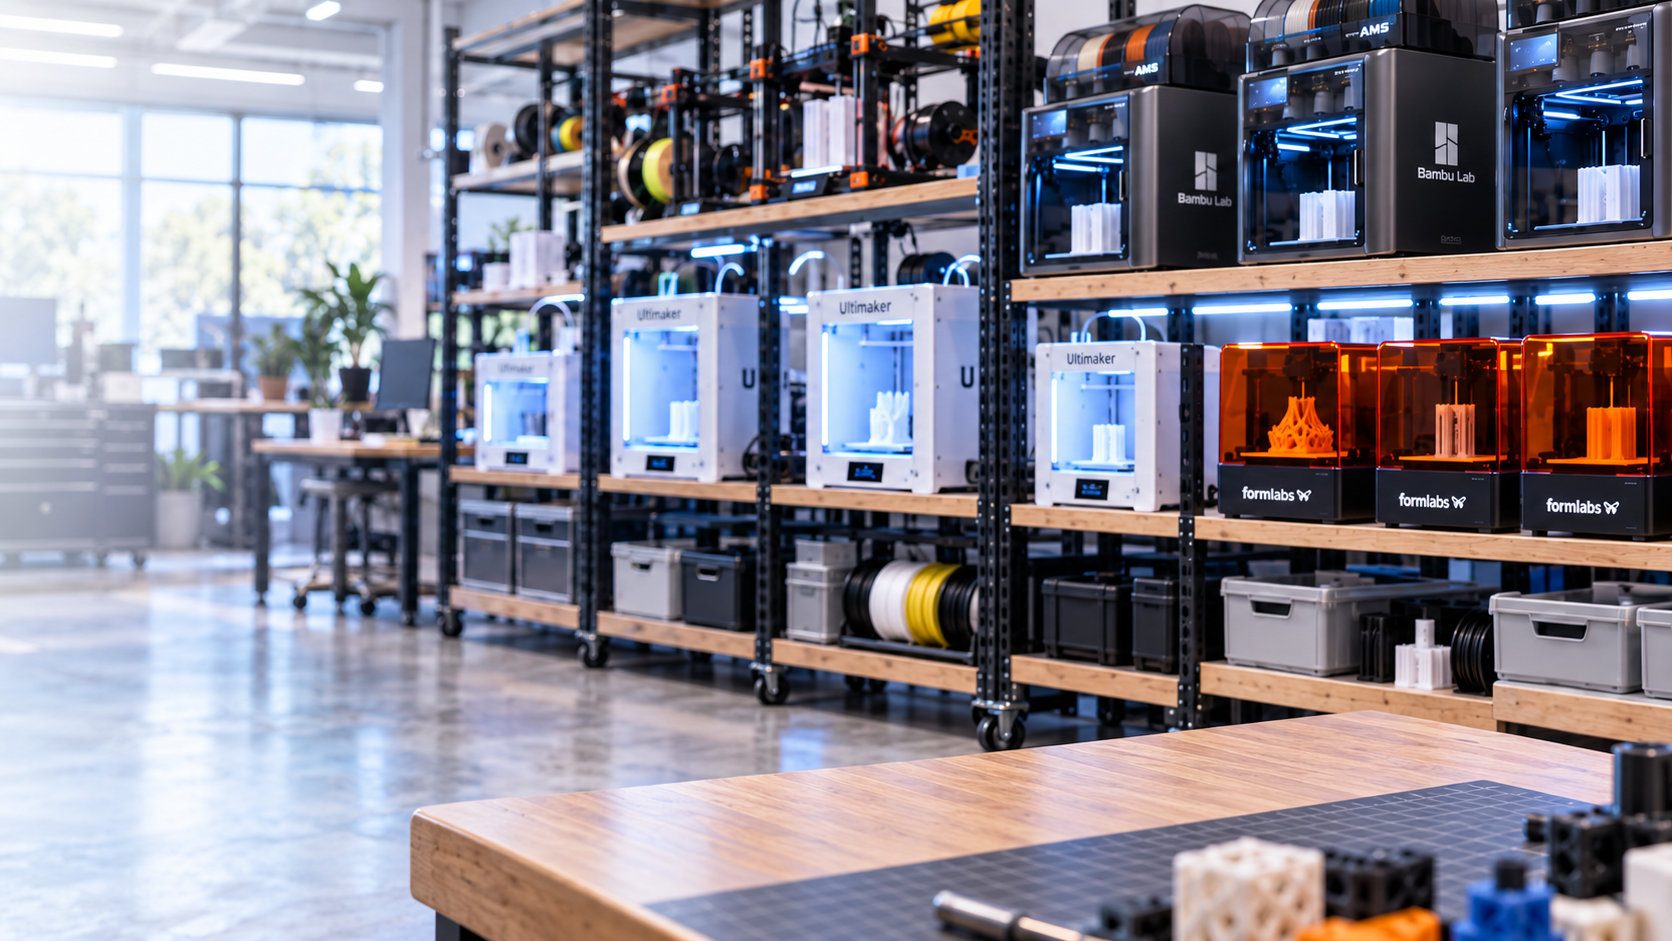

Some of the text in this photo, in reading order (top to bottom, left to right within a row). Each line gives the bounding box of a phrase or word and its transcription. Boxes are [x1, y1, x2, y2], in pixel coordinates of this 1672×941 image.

[1361, 22, 1389, 38] AMS
[1134, 62, 1159, 76] AMS
[1417, 166, 1475, 183] Bambu Lab
[1177, 192, 1232, 207] Bambu Lab
[637, 307, 682, 321] Ultimaker
[839, 300, 892, 315] Ultimaker
[1066, 352, 1116, 365] Ultimaker
[1242, 485, 1296, 502] formlabs
[1398, 492, 1450, 509] formlabs
[1545, 497, 1602, 515] formlabs
